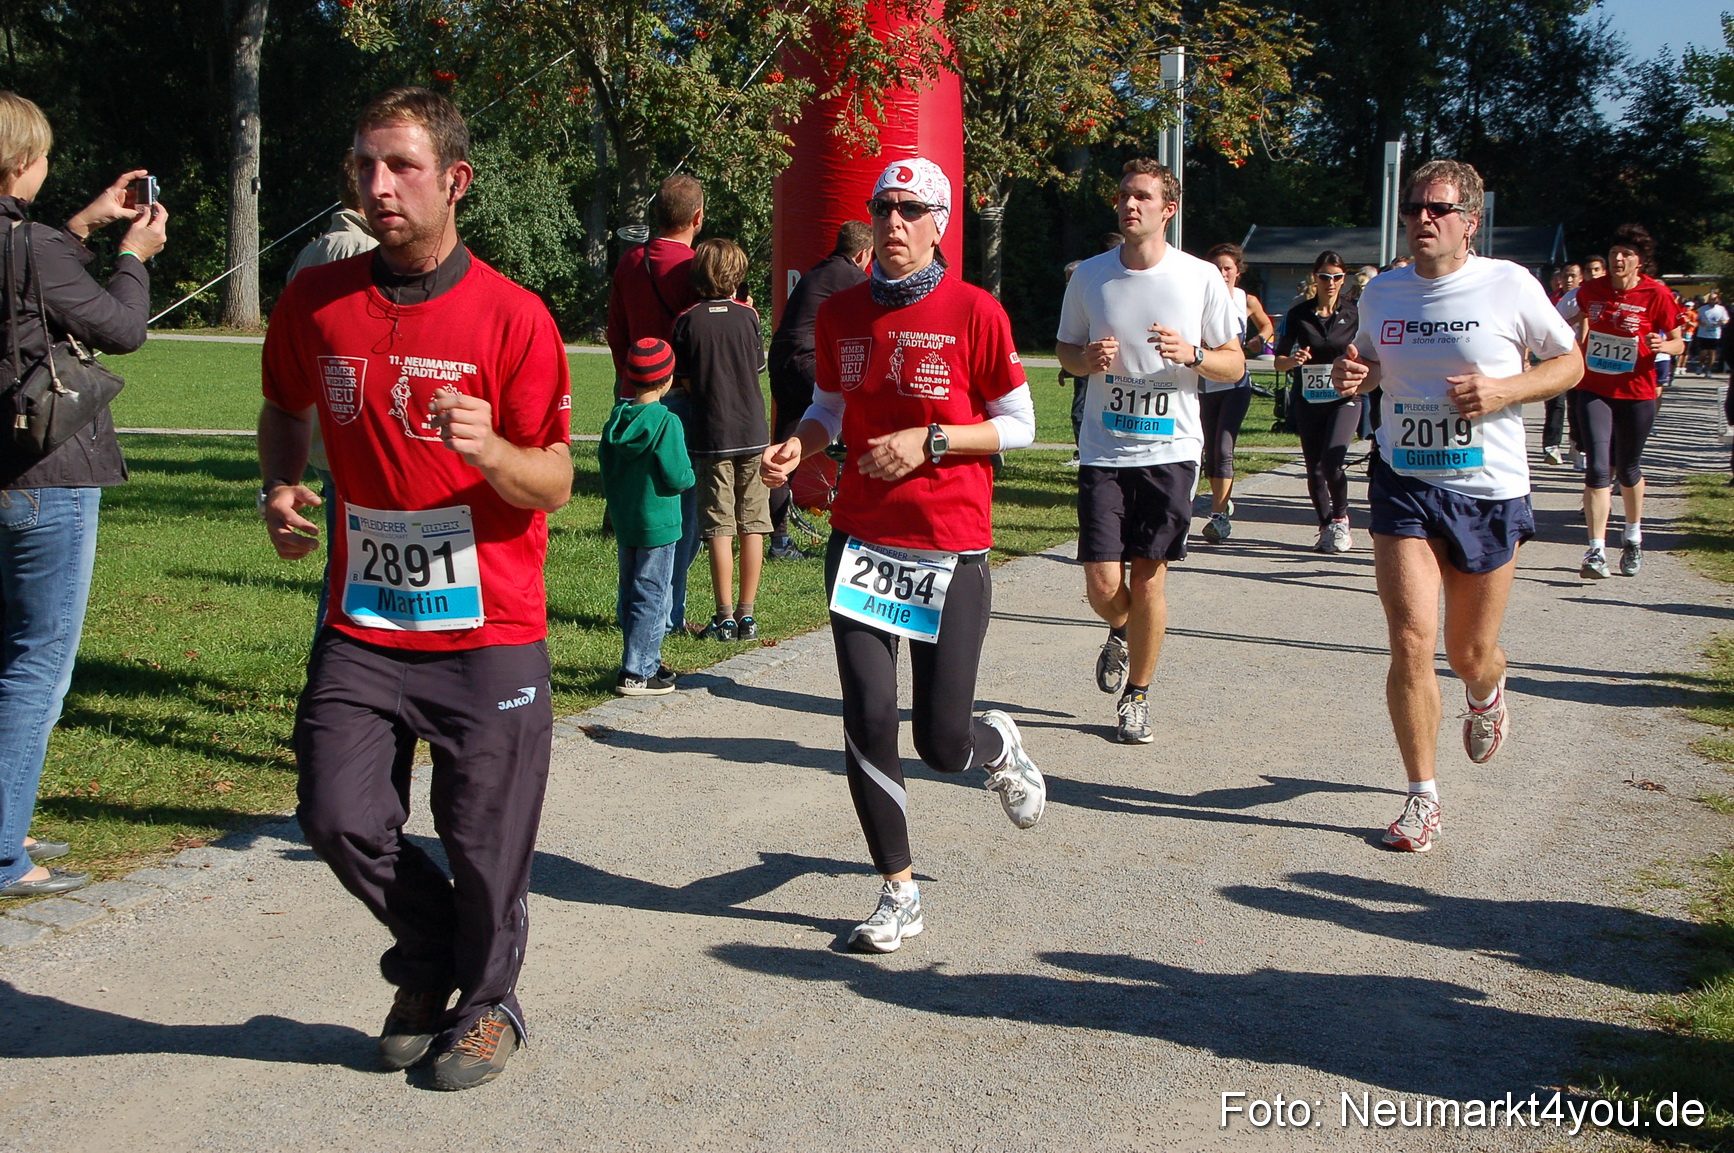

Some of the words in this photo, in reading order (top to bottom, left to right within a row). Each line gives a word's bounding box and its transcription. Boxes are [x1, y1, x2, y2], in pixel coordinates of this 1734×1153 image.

[1406, 321, 1480, 336] Egner
[888, 331, 899, 339] 11.
[900, 331, 956, 345] NEUMARKTER
[897, 339, 944, 350] STADTLAUF
[841, 345, 865, 354] IMMER
[1592, 342, 1632, 361] 2112
[389, 355, 403, 366] 11.
[404, 356, 477, 375] NEUMARKTER
[841, 353, 865, 362] WIEDER
[1597, 359, 1622, 370] Agnes
[324, 366, 356, 377] IMMER
[401, 365, 463, 382] STADTLAUF
[842, 362, 863, 374] NEU
[325, 376, 357, 388] WIEDER
[1114, 375, 1146, 385] PFLEIDERER
[1307, 374, 1332, 389] 257
[328, 387, 354, 403] NEU
[1110, 387, 1169, 416] 3110
[1404, 403, 1439, 412] PFLEIDERER
[1115, 414, 1160, 431] Florian
[1401, 418, 1472, 447] 2019
[1407, 450, 1468, 466] Günther
[361, 517, 407, 533] PFLEIDERER
[362, 538, 456, 587] 2891
[353, 573, 358, 581] B
[850, 556, 937, 605] 2854
[377, 588, 449, 615] Martin
[863, 595, 911, 624] Antje
[498, 696, 530, 711] JAKO
